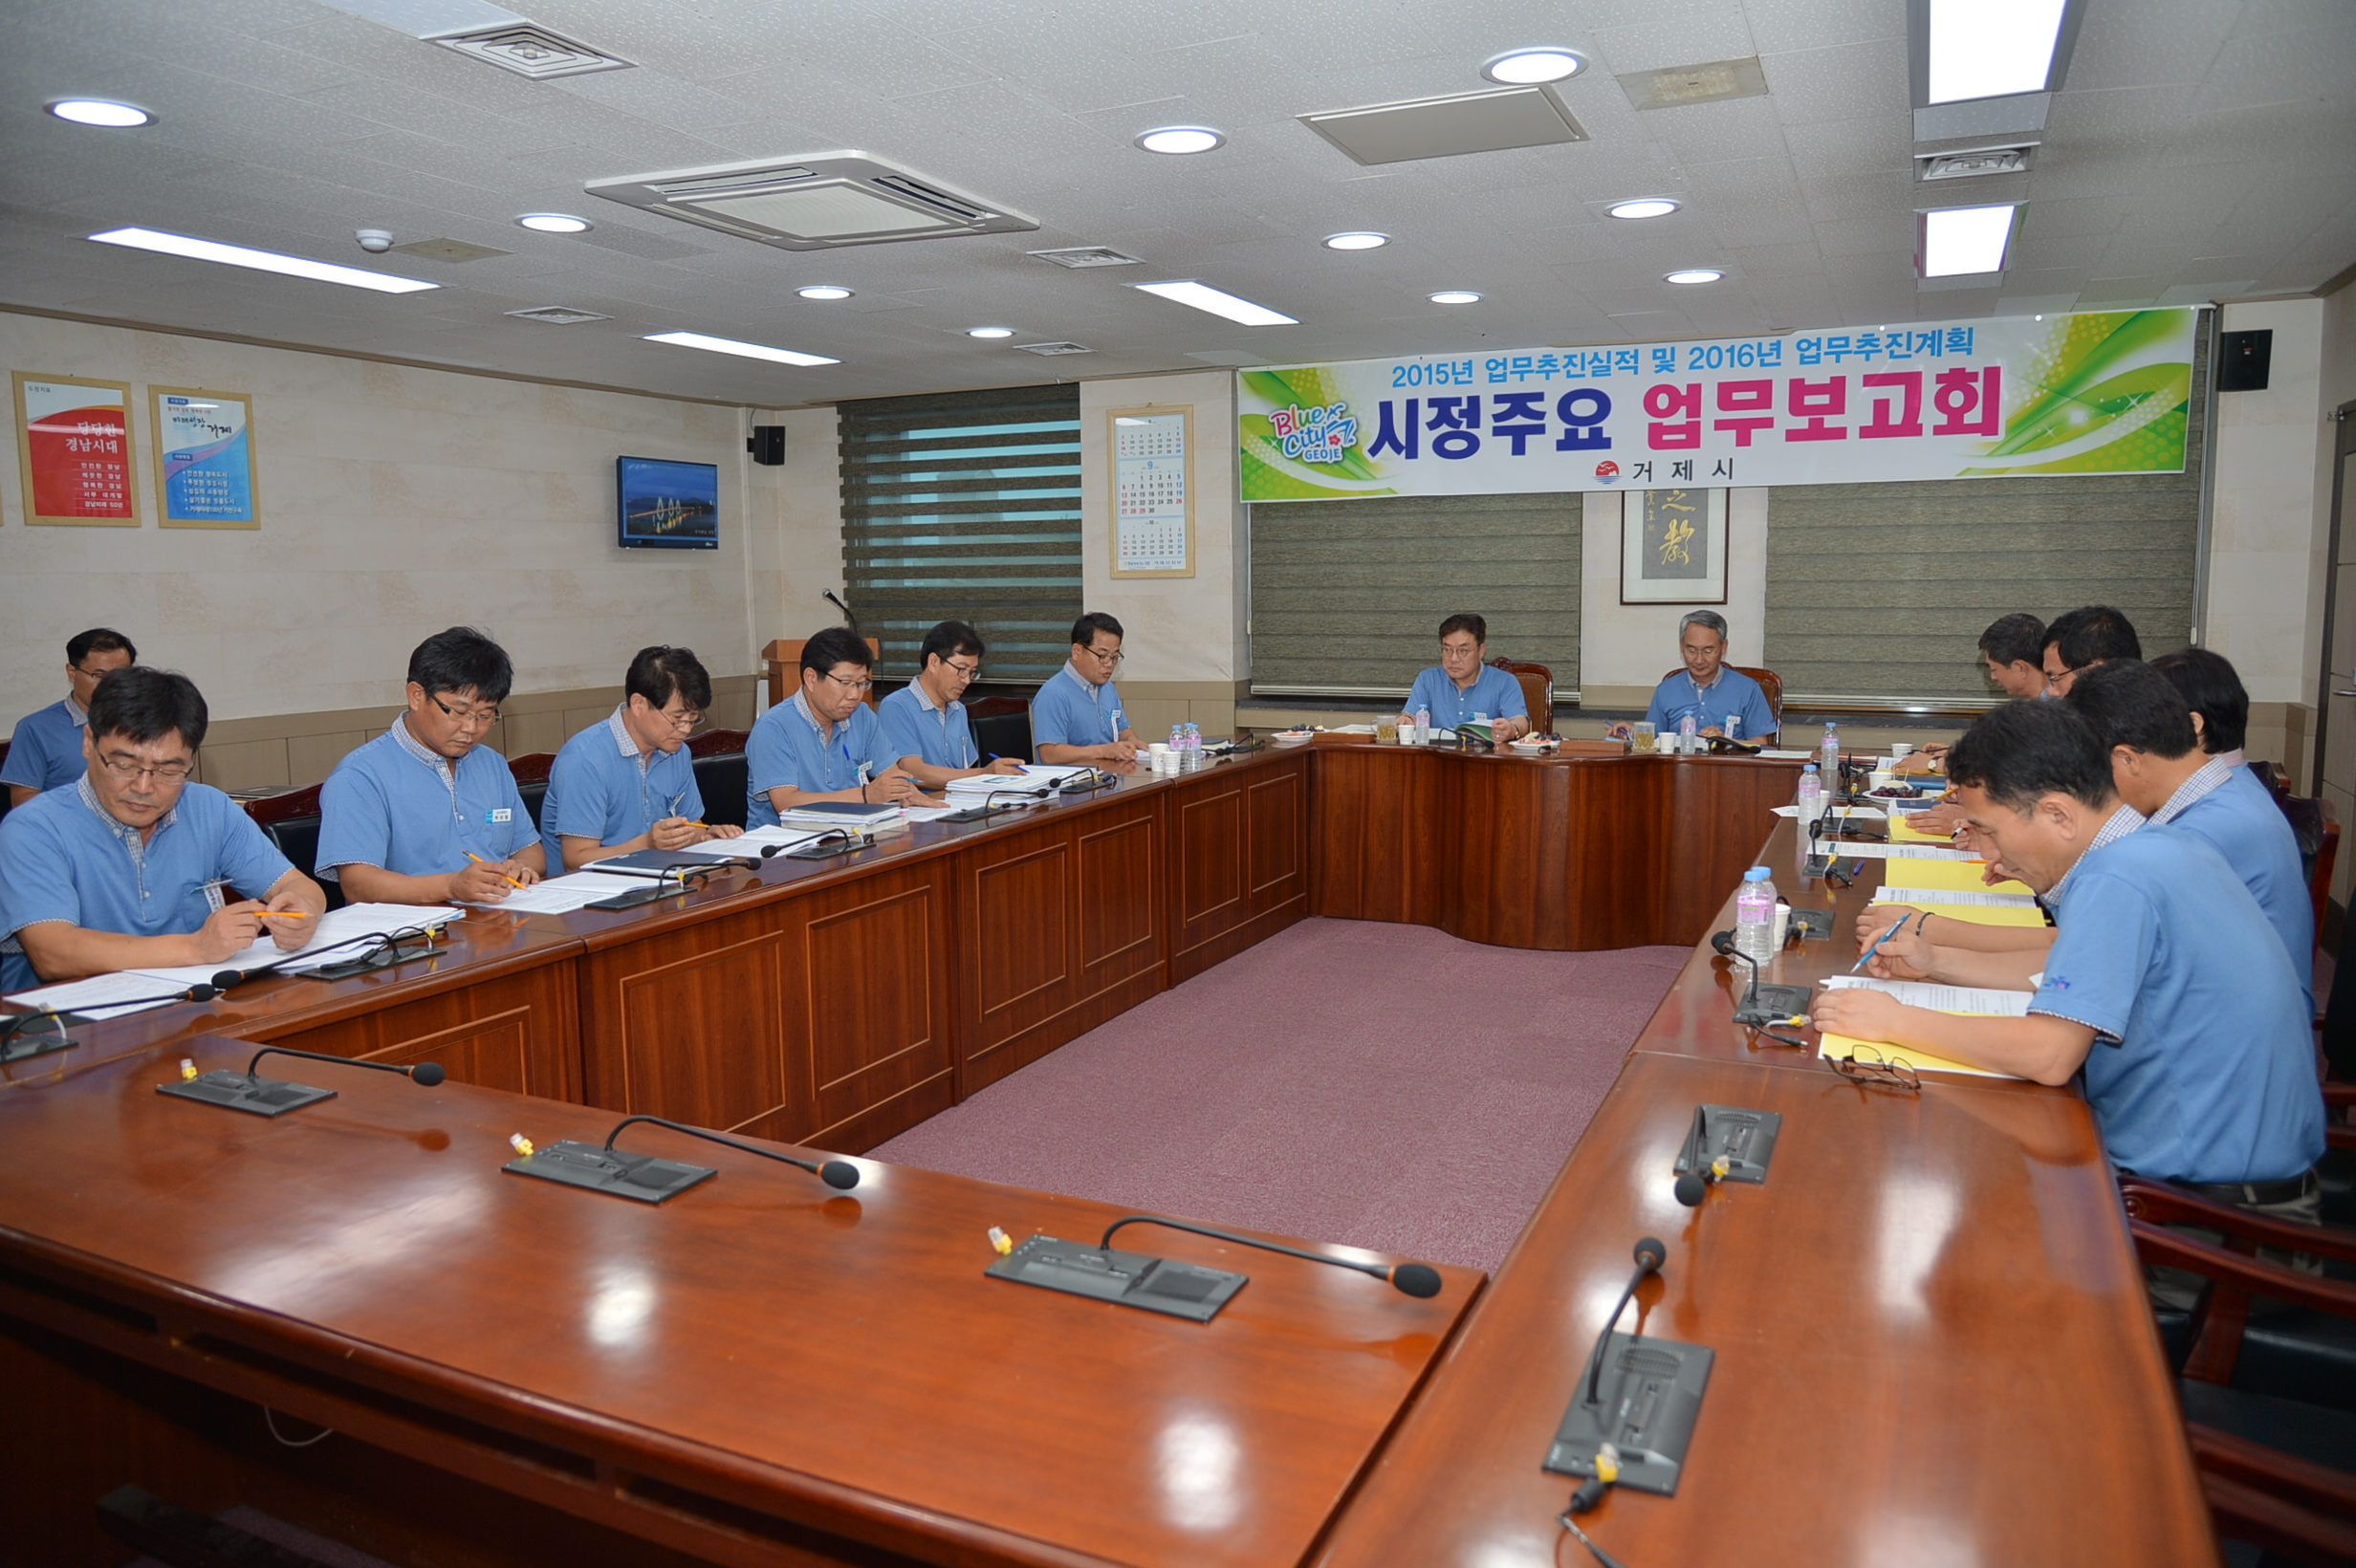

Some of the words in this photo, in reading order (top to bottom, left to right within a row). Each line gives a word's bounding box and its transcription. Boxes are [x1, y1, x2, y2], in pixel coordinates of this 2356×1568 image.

[1392, 359, 1473, 388] 2015년
[1485, 348, 1640, 384] 업무추진실적
[1651, 346, 1676, 374] 및
[1689, 339, 1783, 371] 2016년
[1795, 326, 1974, 364] 업무추진계획
[1271, 405, 1325, 436] Blue
[1367, 387, 1613, 460] 시정주요
[1643, 365, 2002, 450] 업무보고회
[77, 421, 117, 437] 당당한
[1285, 425, 1326, 455] City
[65, 437, 118, 454] 경남시대
[1304, 448, 1341, 461] GEOJE
[1147, 461, 1153, 470] 9
